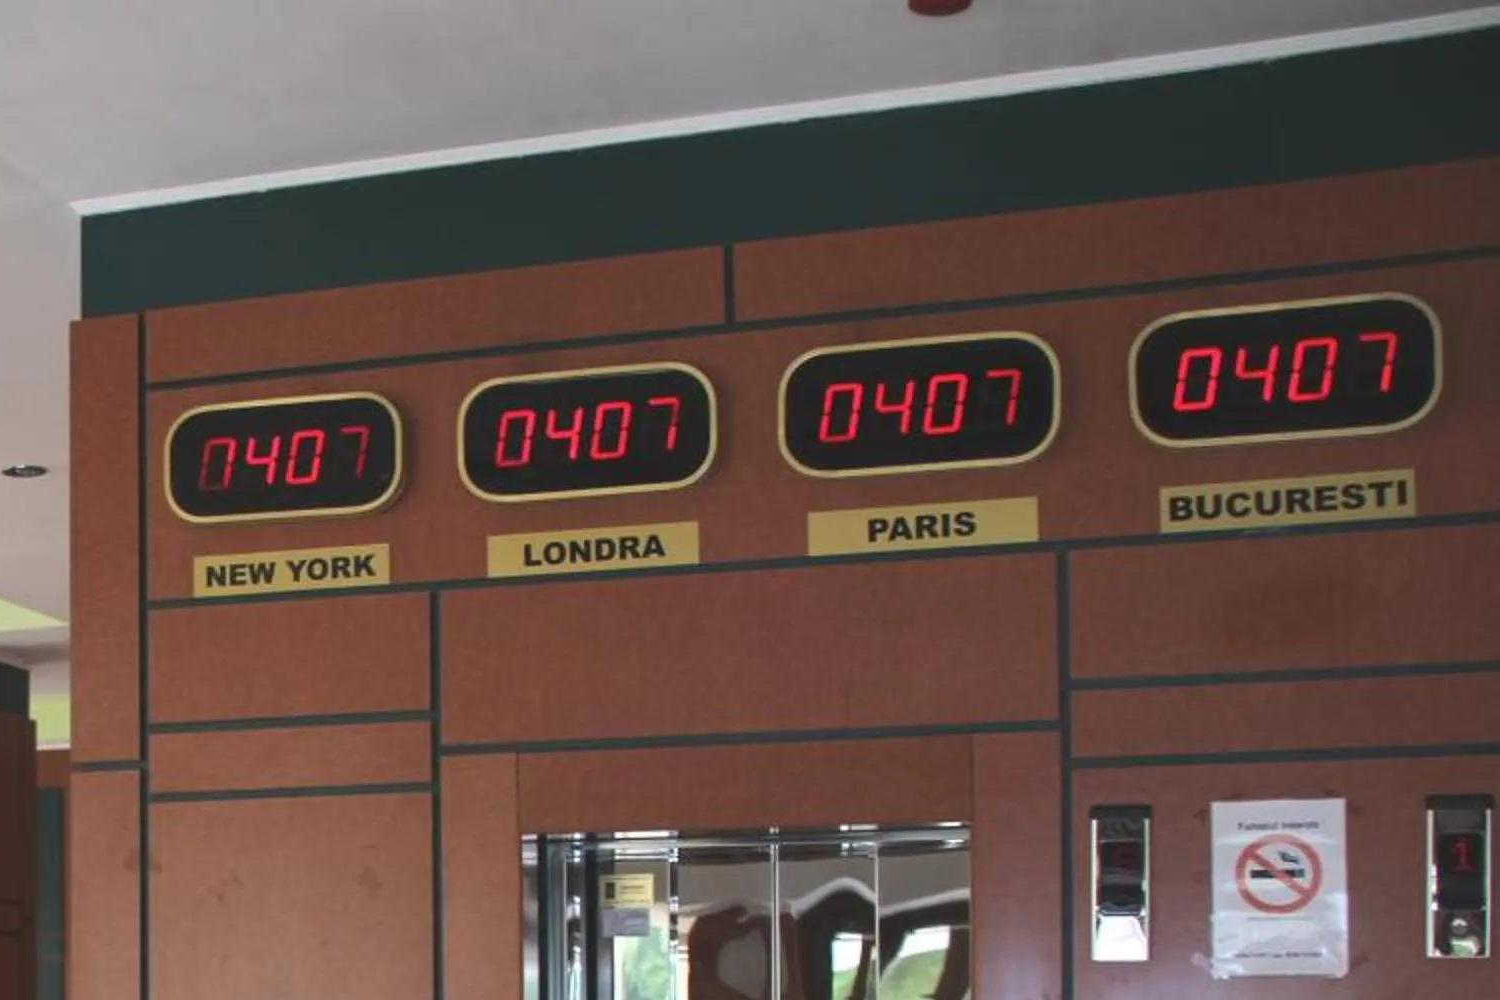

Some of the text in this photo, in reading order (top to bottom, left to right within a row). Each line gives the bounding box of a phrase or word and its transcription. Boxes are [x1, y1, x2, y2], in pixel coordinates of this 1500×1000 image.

[1172, 331, 1401, 414] 0407
[817, 368, 1024, 445] 0407
[494, 396, 684, 470] 0407
[1167, 480, 1408, 522] BUCURESTI
[867, 511, 977, 543] PARIS
[206, 554, 376, 588] NEW YORK
[522, 534, 666, 568] LONDRA
